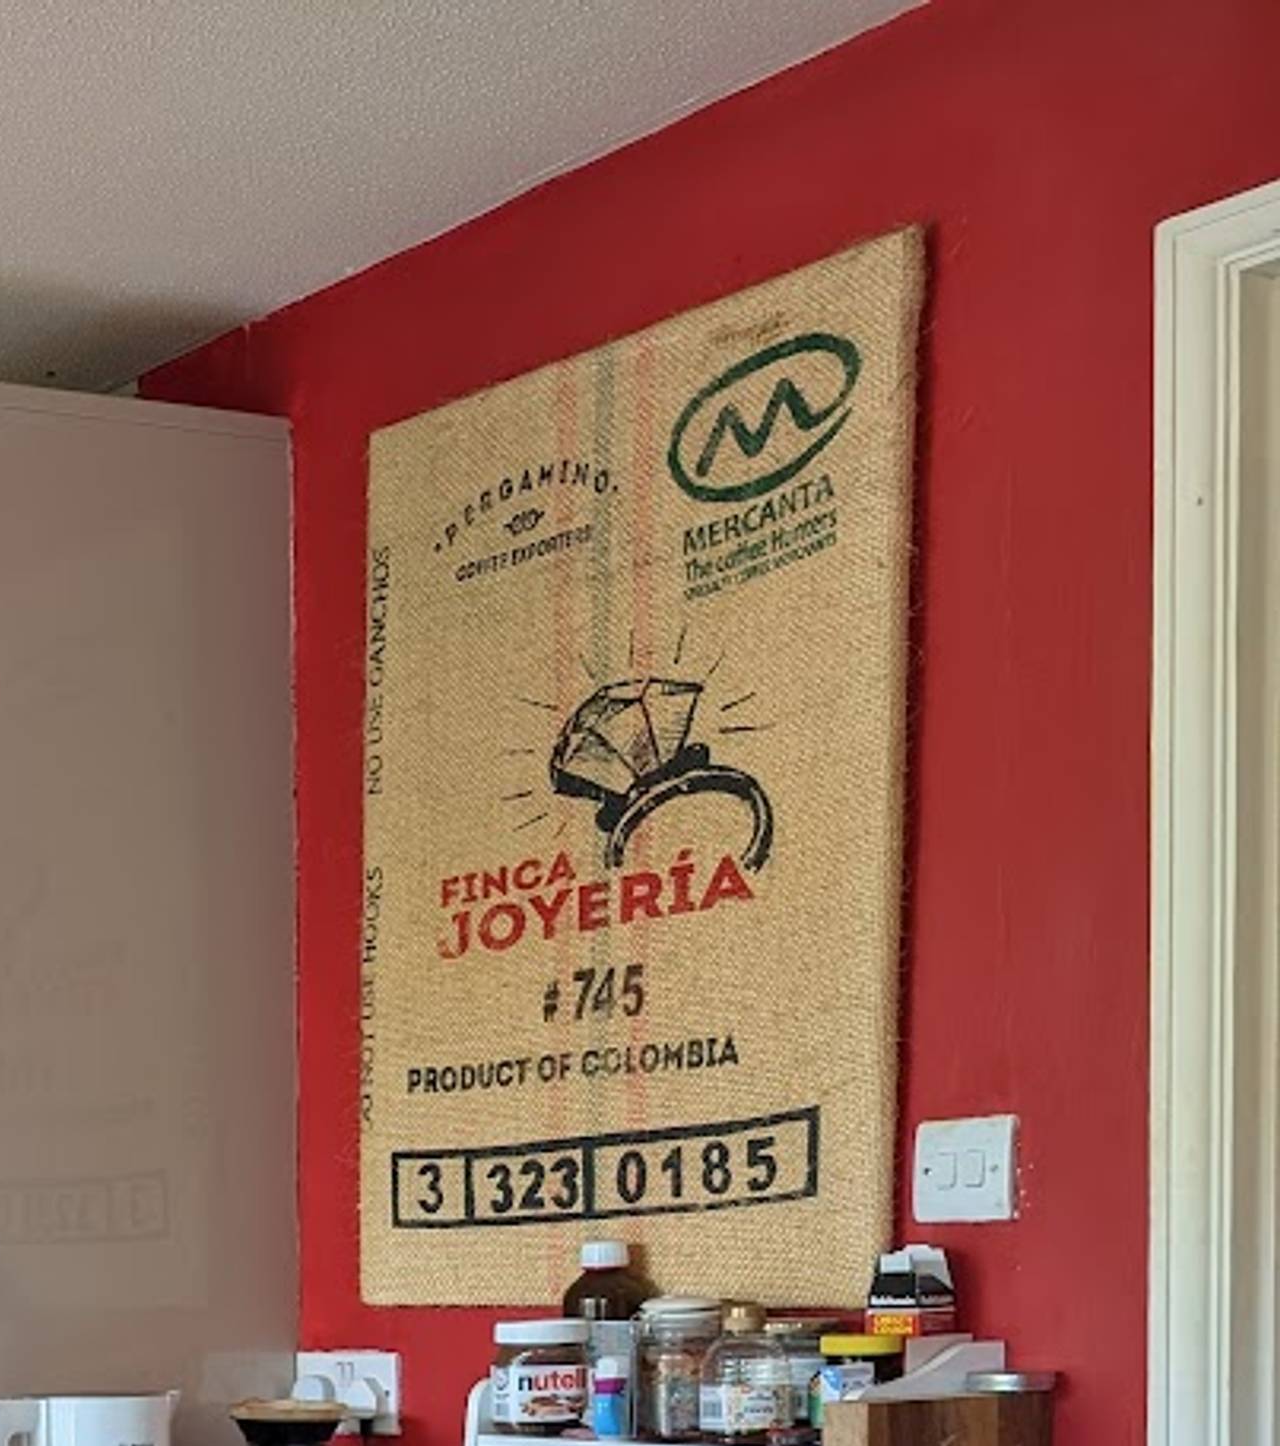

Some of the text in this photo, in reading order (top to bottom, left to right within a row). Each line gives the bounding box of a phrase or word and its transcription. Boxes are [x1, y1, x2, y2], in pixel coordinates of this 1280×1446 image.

[682, 473, 835, 556] MERCANTA
[684, 556, 713, 582] The
[367, 544, 390, 795] NO USE GANCHOS
[363, 865, 384, 964] HOOKS
[436, 846, 756, 961] JOYERÍA
[439, 849, 578, 910] FINCA
[406, 1035, 740, 1095] PRODUCT OF COLOMBIA
[416, 1135, 779, 1215] 3 323 0185
[517, 1367, 588, 1391] nutell
